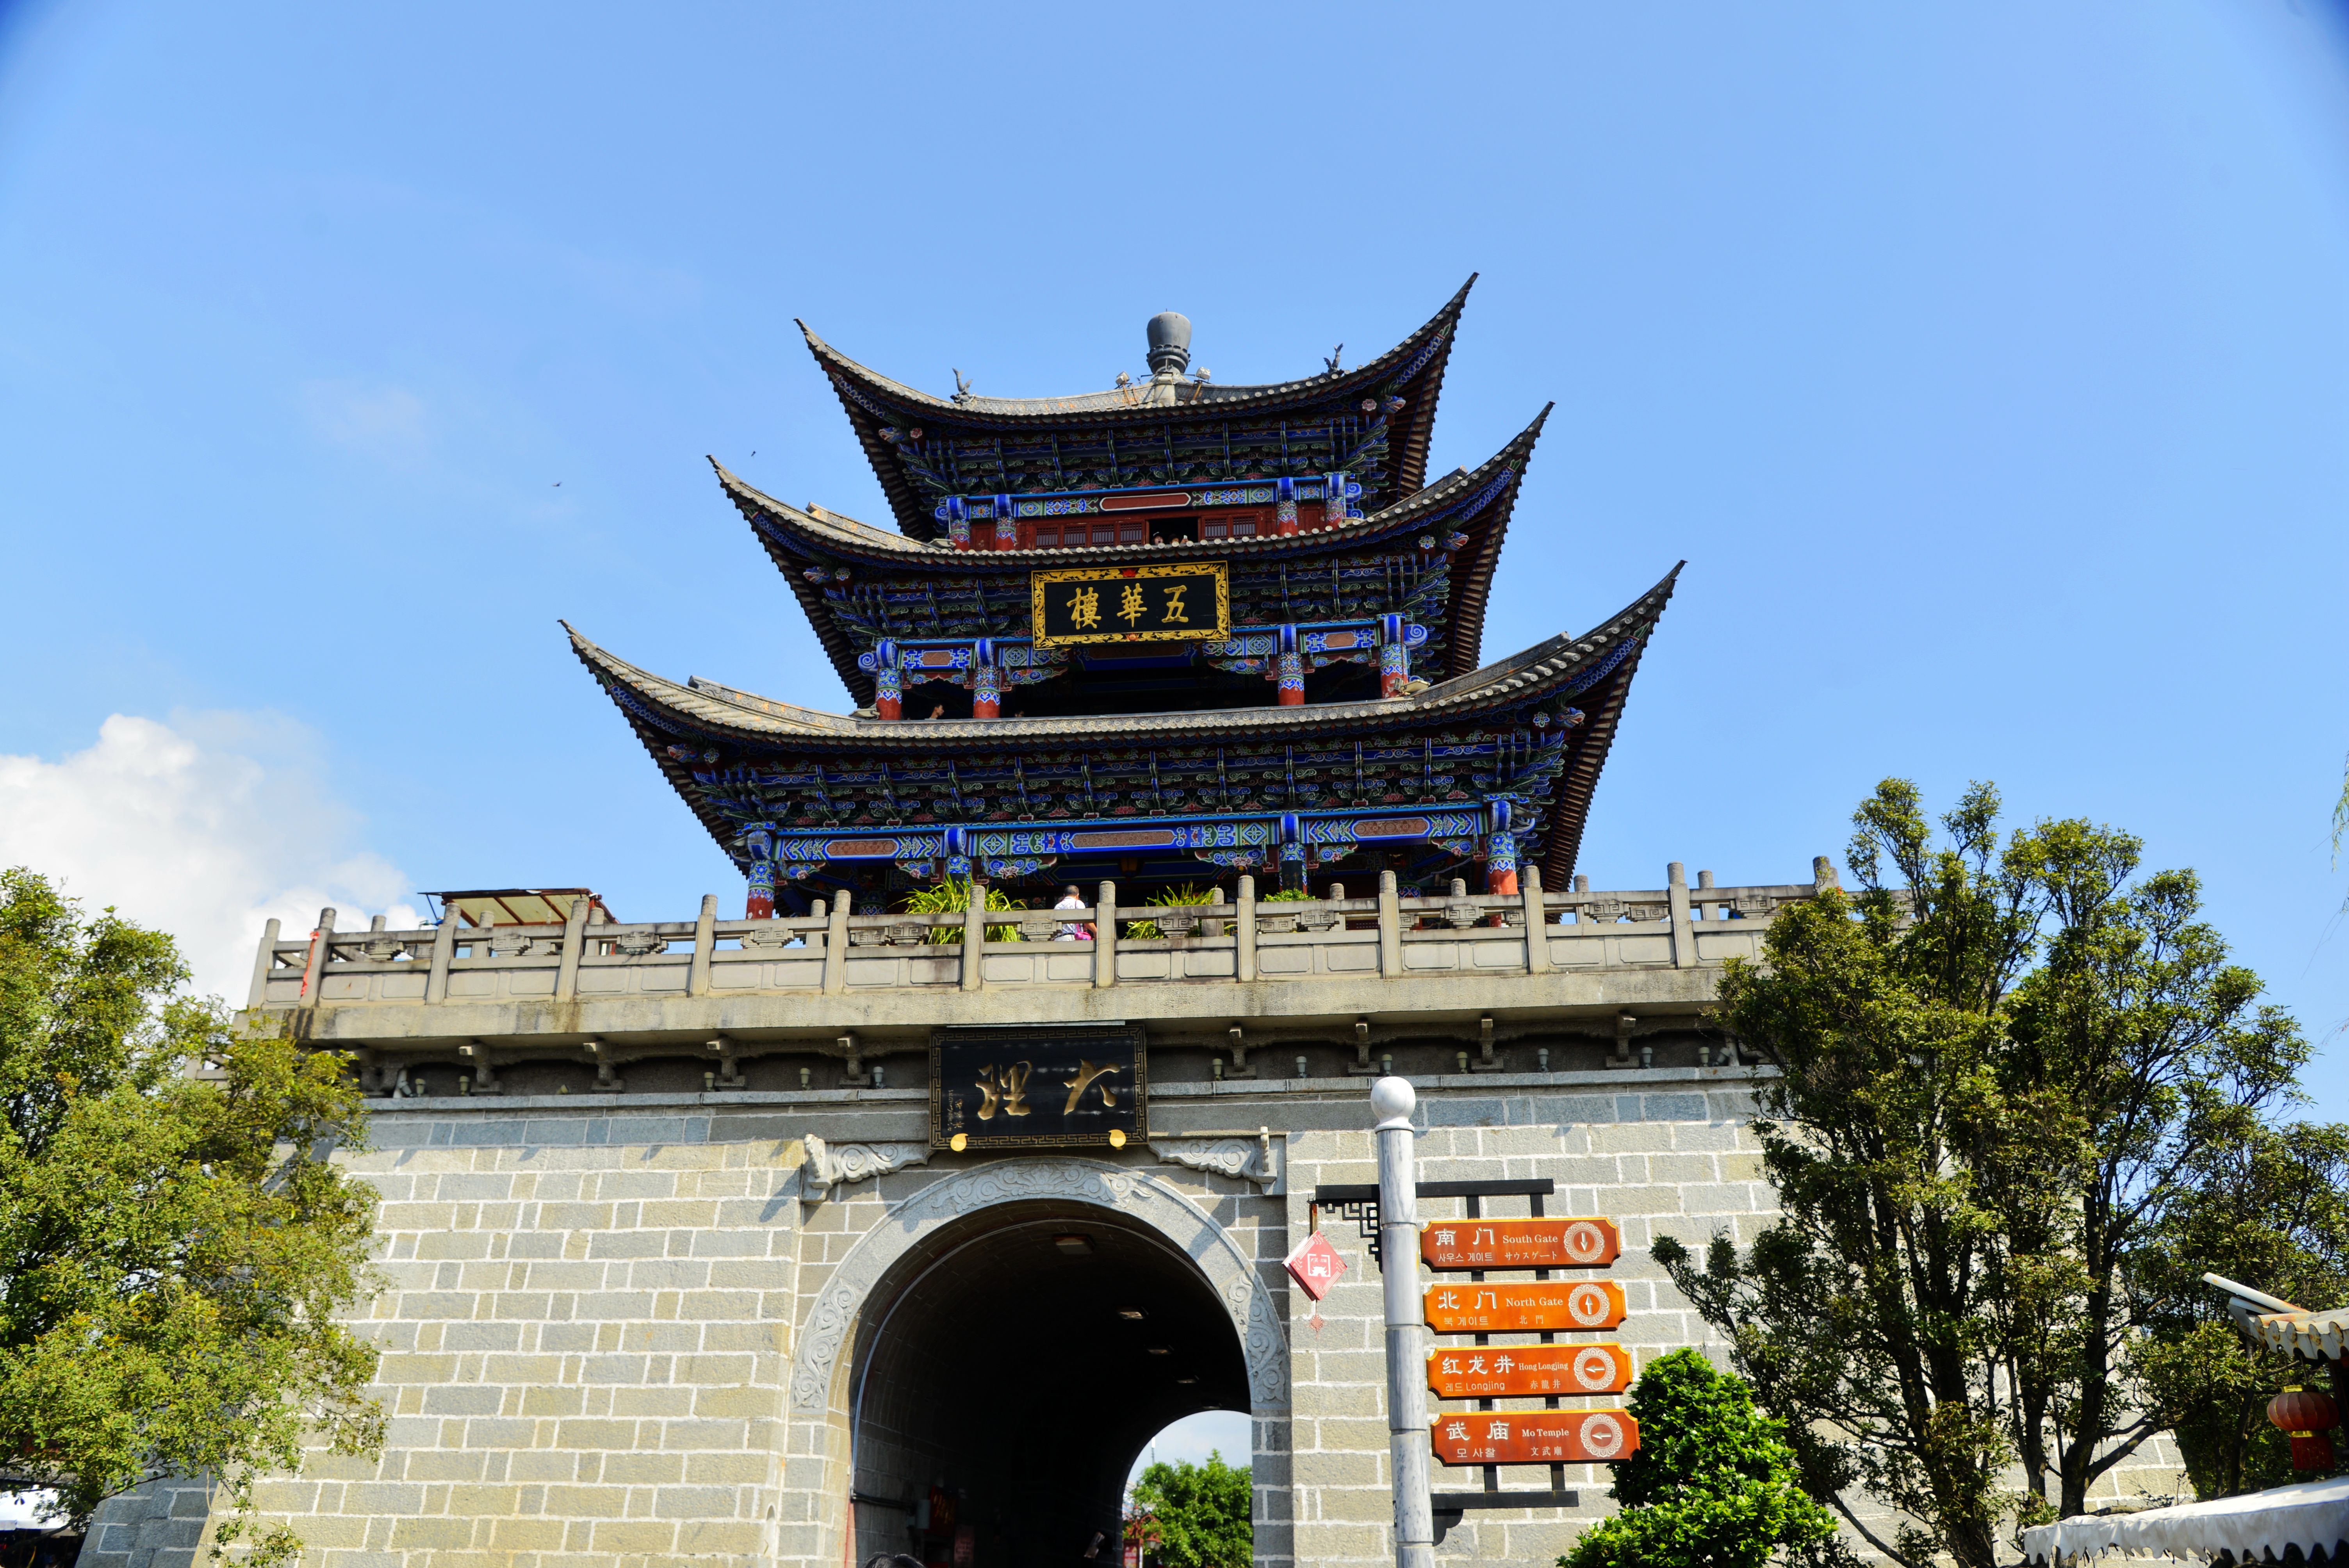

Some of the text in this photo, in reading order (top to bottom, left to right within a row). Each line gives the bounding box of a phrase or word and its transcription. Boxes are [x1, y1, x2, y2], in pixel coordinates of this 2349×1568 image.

[1435, 1227, 1495, 1246] 南门
[1502, 1235, 1558, 1244] South Gate
[1438, 1253, 1493, 1262] 사우스 게이트
[1504, 1251, 1557, 1261] サウスゲート
[1438, 1290, 1497, 1310] 北门
[1506, 1297, 1563, 1307] North Gate
[1444, 1316, 1488, 1326] 북 게이트
[1519, 1315, 1543, 1325] 北門
[1442, 1355, 1515, 1375] 红龙井
[1518, 1363, 1568, 1372] Hong Longjing
[1445, 1382, 1505, 1392] 레드 Longjing
[1531, 1379, 1561, 1389] 赤龍井
[1446, 1420, 1510, 1441] 武庙
[1536, 1428, 1569, 1438] Temple
[1531, 1446, 1562, 1456] 文武廟
